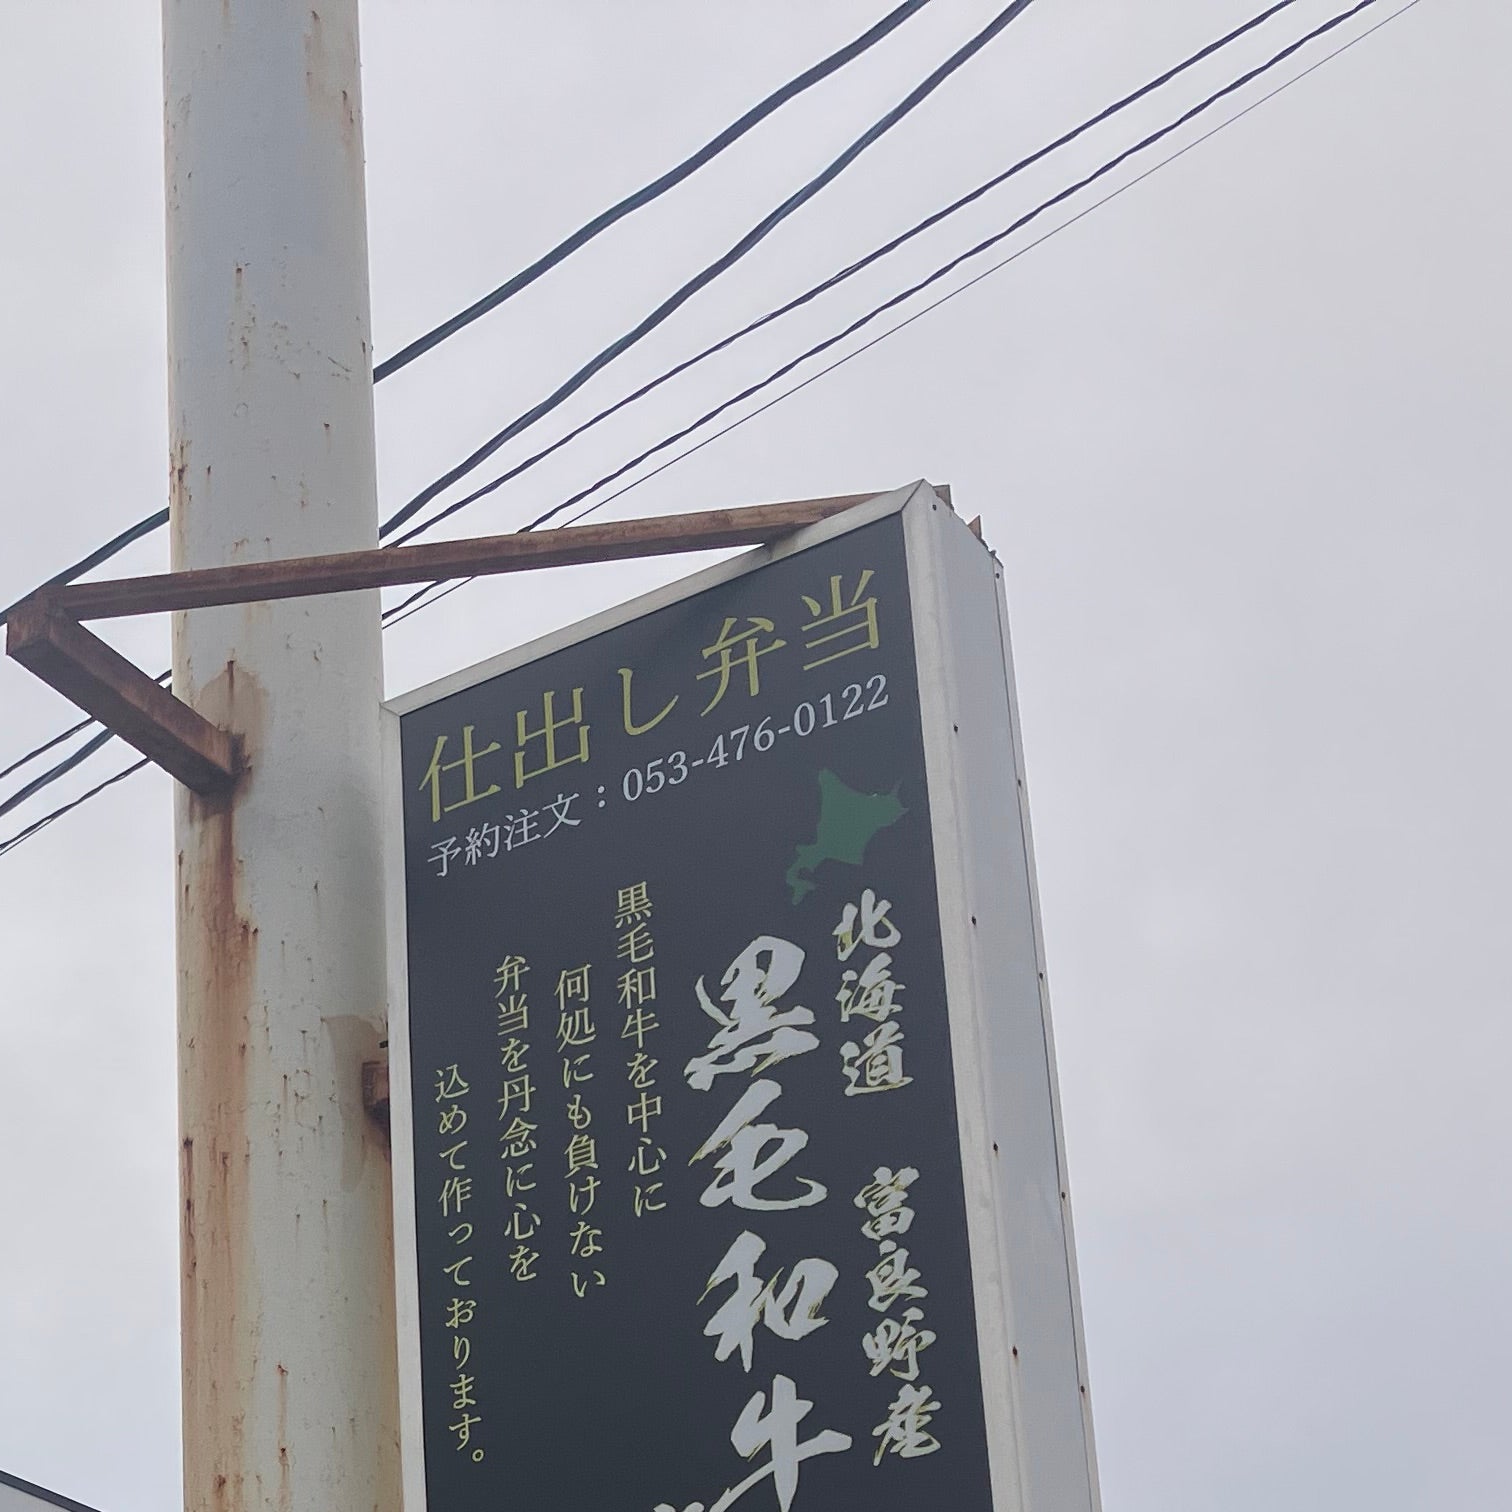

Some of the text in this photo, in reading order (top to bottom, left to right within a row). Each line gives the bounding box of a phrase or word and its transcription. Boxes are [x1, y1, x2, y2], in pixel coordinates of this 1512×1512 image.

[418, 569, 880, 823] 仕出し弁当
[493, 954, 542, 1283] 弁当を丹念に心を
[554, 963, 606, 1298] 何処にも負けない
[615, 881, 667, 1218] 黒毛和牛を中心に
[831, 888, 914, 1097] 北海道
[434, 1063, 485, 1463] 込めて作っております。
